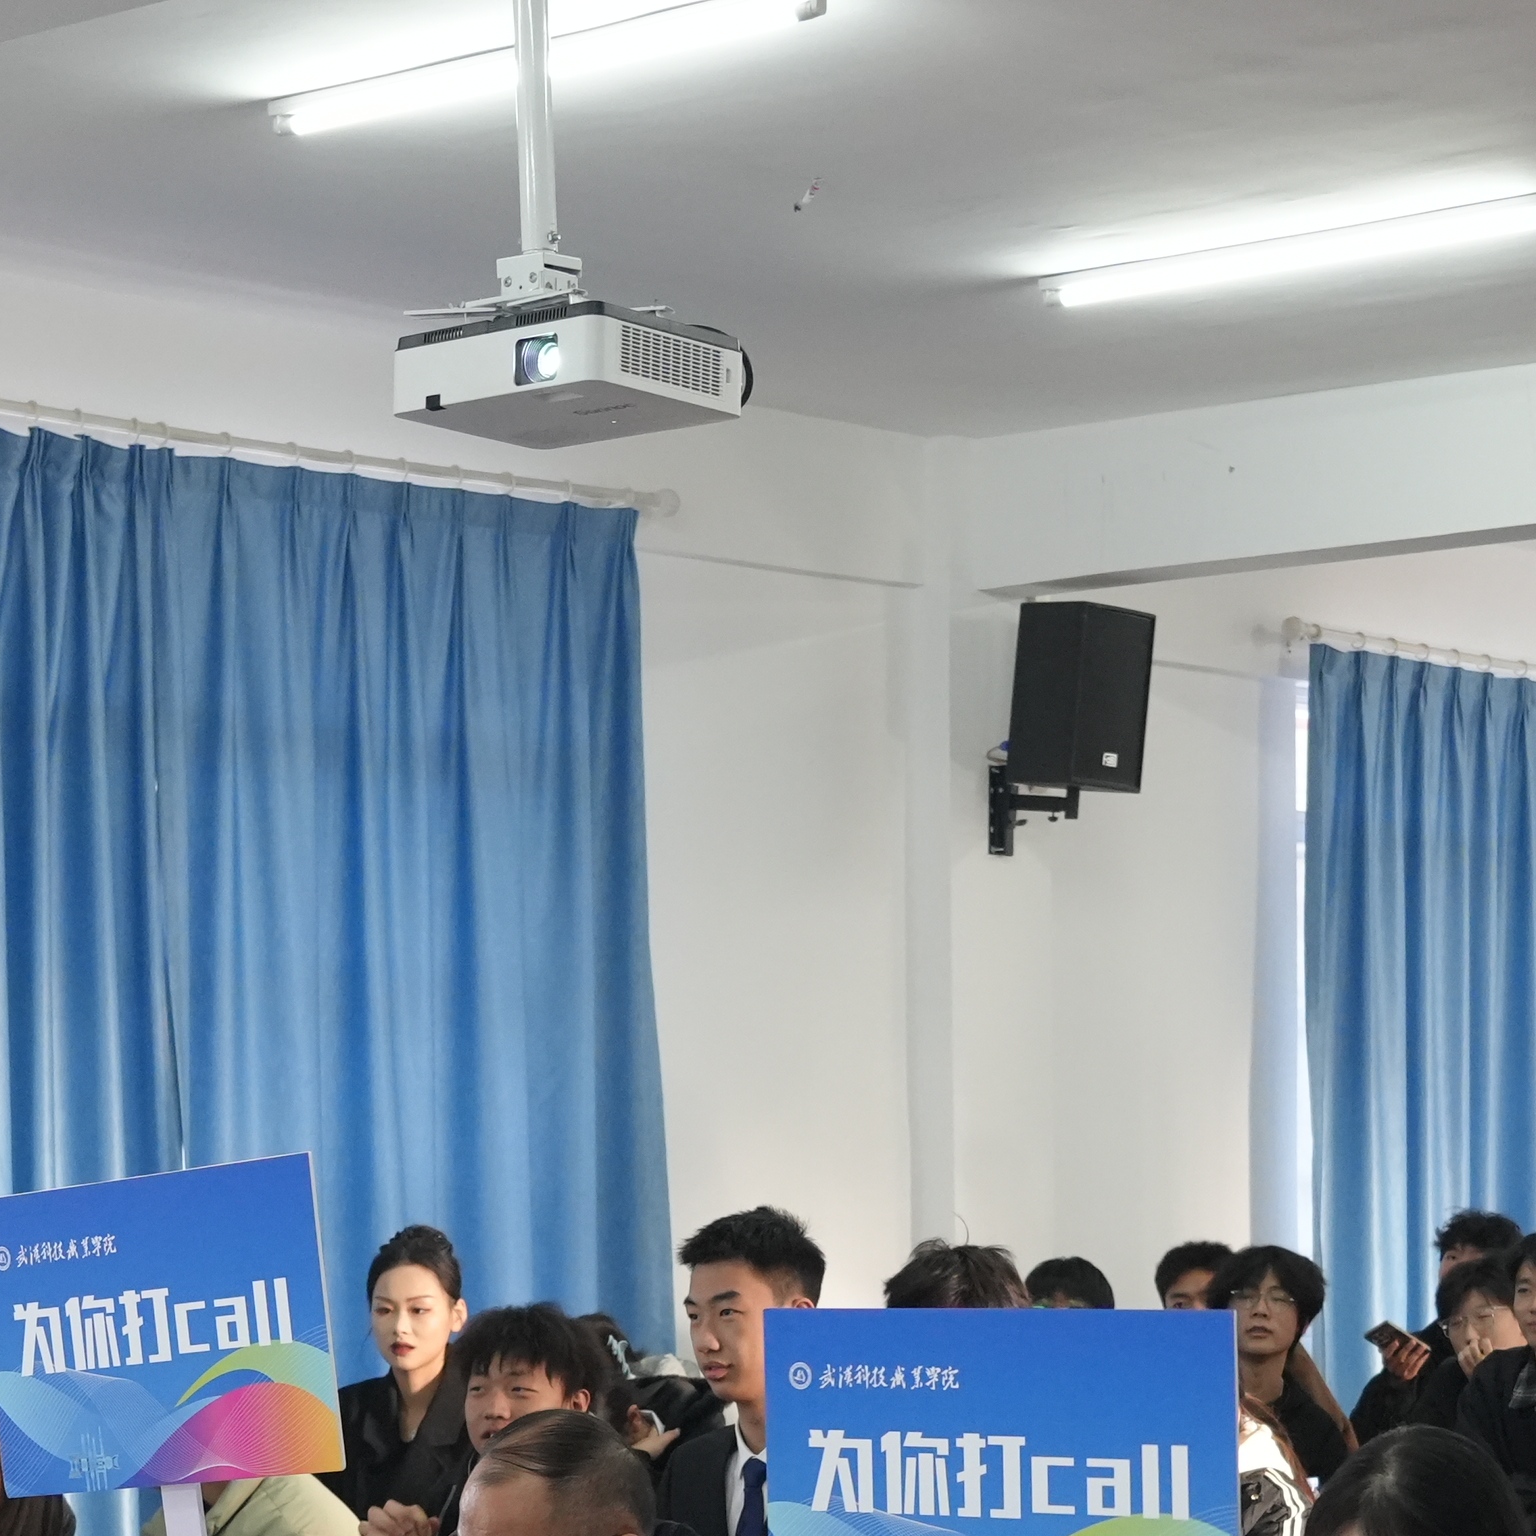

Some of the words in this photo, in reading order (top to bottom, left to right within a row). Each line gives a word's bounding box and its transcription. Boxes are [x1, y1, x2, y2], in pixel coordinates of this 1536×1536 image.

[13, 1277, 293, 1378] 为你打call
[808, 1429, 1191, 1521] 为你打call
